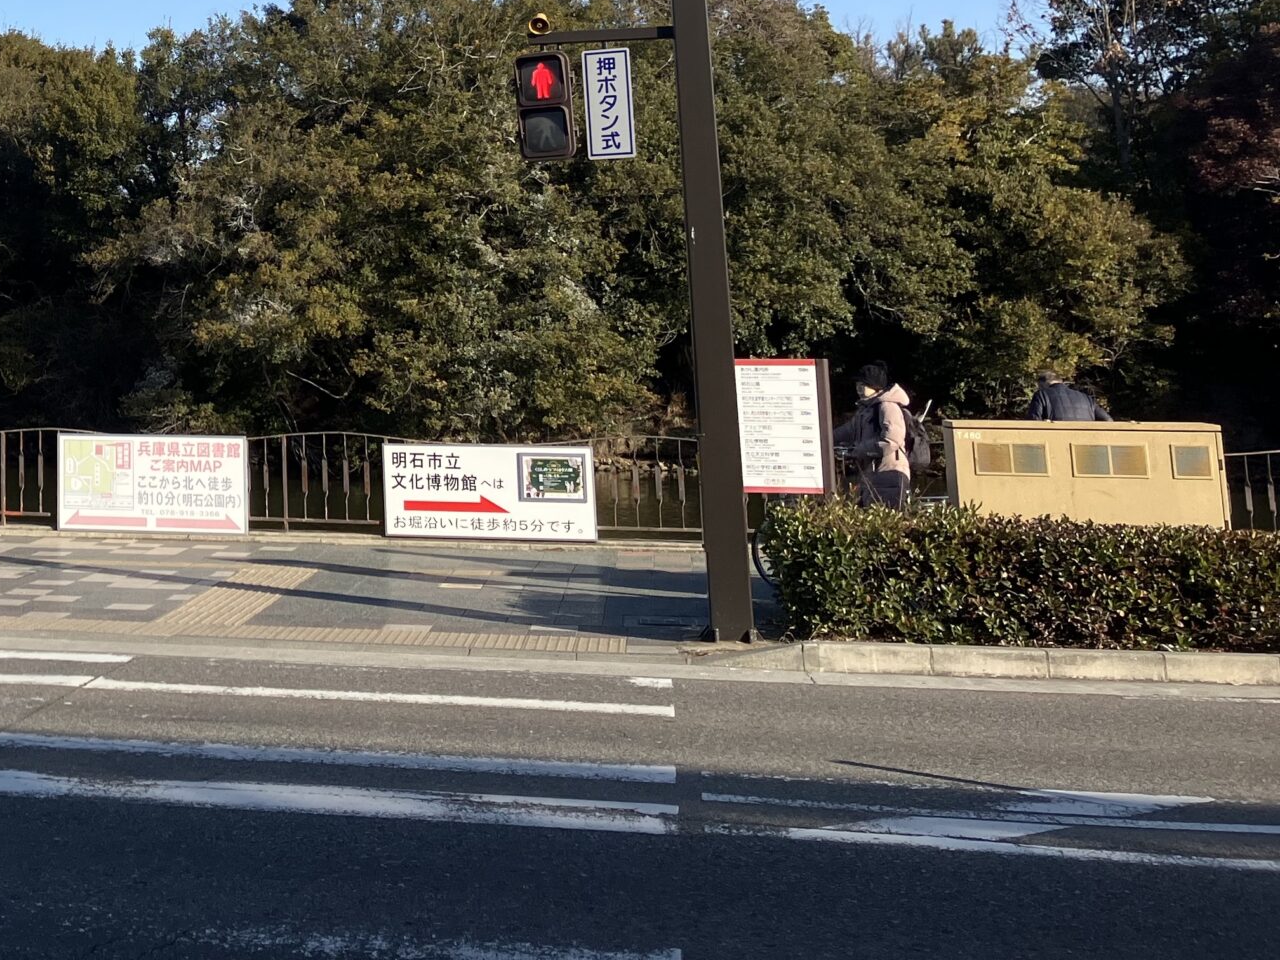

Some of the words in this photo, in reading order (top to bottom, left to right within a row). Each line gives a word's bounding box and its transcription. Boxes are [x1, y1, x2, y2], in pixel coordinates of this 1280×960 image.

[596, 57, 621, 150] 押ボタン式
[137, 441, 241, 458] 兵庫県立図書館
[150, 458, 223, 473] ご案内MAP
[391, 452, 461, 470] 明石市立
[137, 475, 233, 491] ここから北へ徒歩
[393, 515, 584, 534] お堀沿いに徒歩約5分です。
